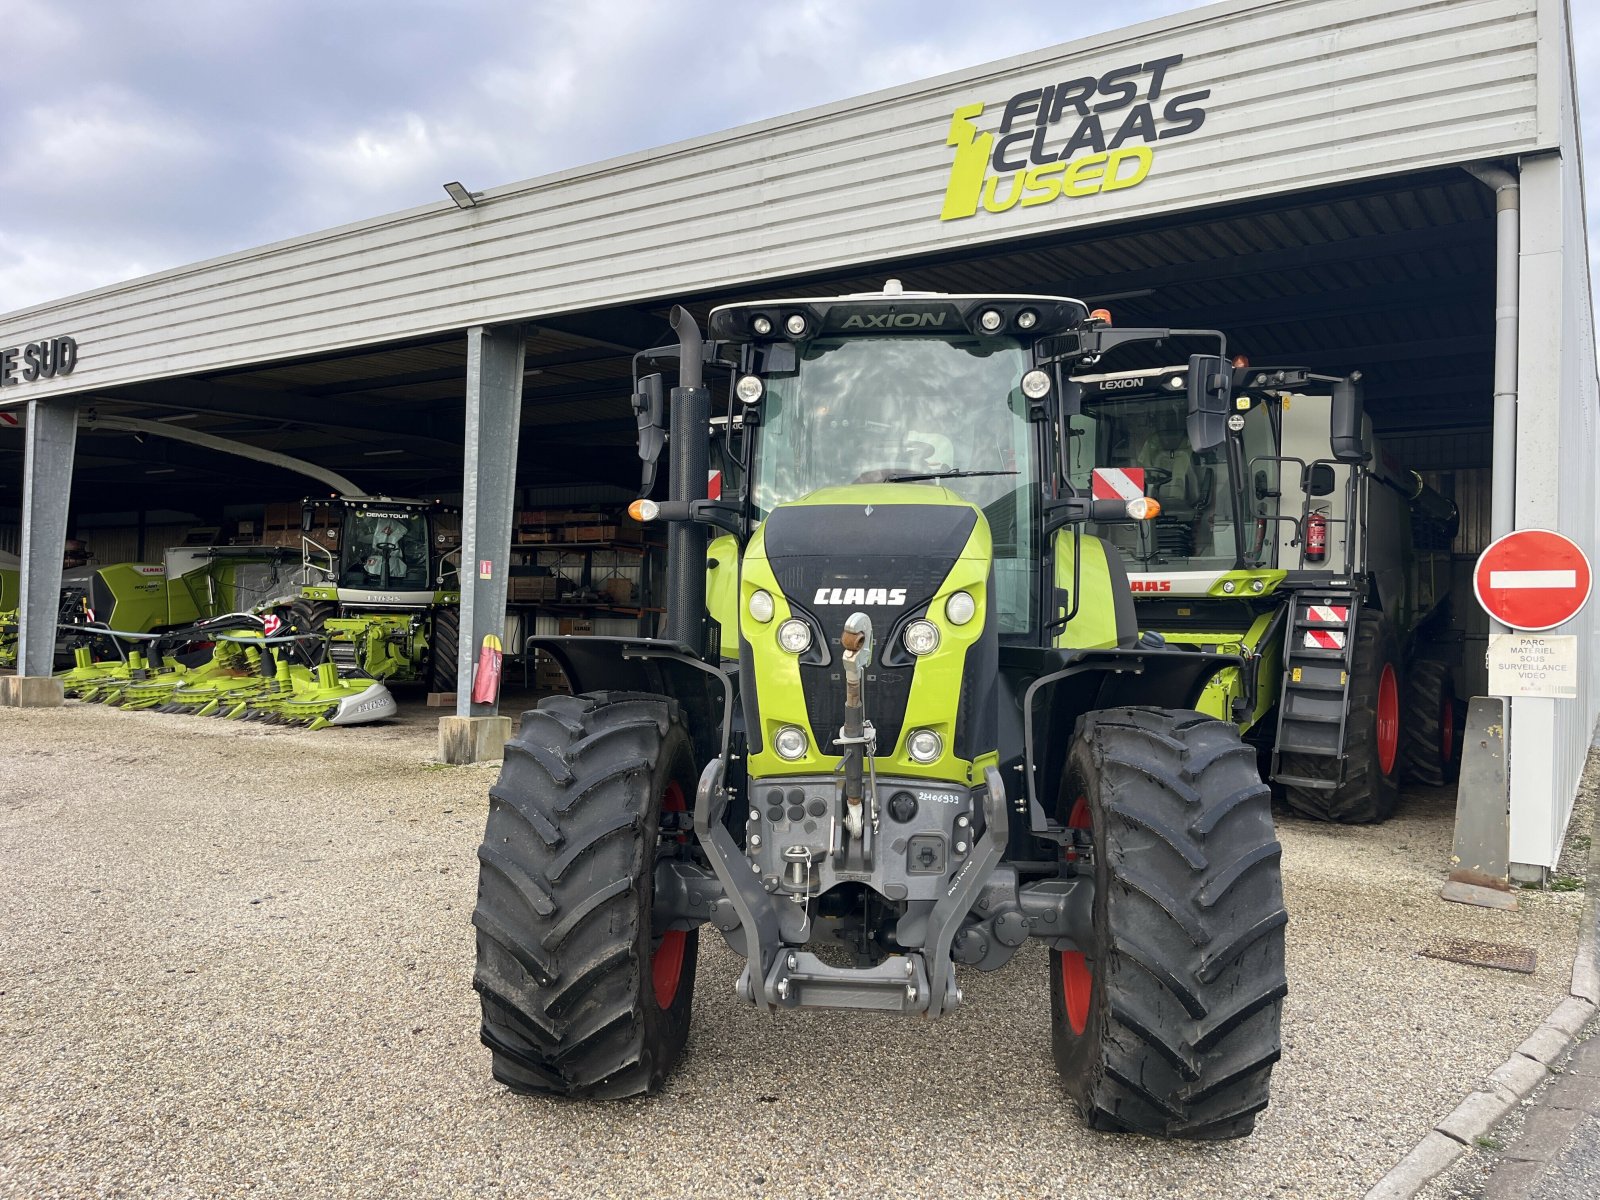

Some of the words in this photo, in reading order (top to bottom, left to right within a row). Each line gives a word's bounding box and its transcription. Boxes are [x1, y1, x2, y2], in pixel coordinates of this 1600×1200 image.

[999, 54, 1184, 134] FIRST
[992, 89, 1211, 172] CLAAS
[982, 146, 1153, 213] USED
[841, 312, 947, 329] AXION
[22, 336, 79, 382] SUD
[1099, 378, 1144, 391] LEXION
[1130, 581, 1171, 592] AAS
[813, 588, 907, 605] CLAAS
[1498, 663, 1569, 672] SURVEILLANCE
[1519, 655, 1545, 663] SOUS
